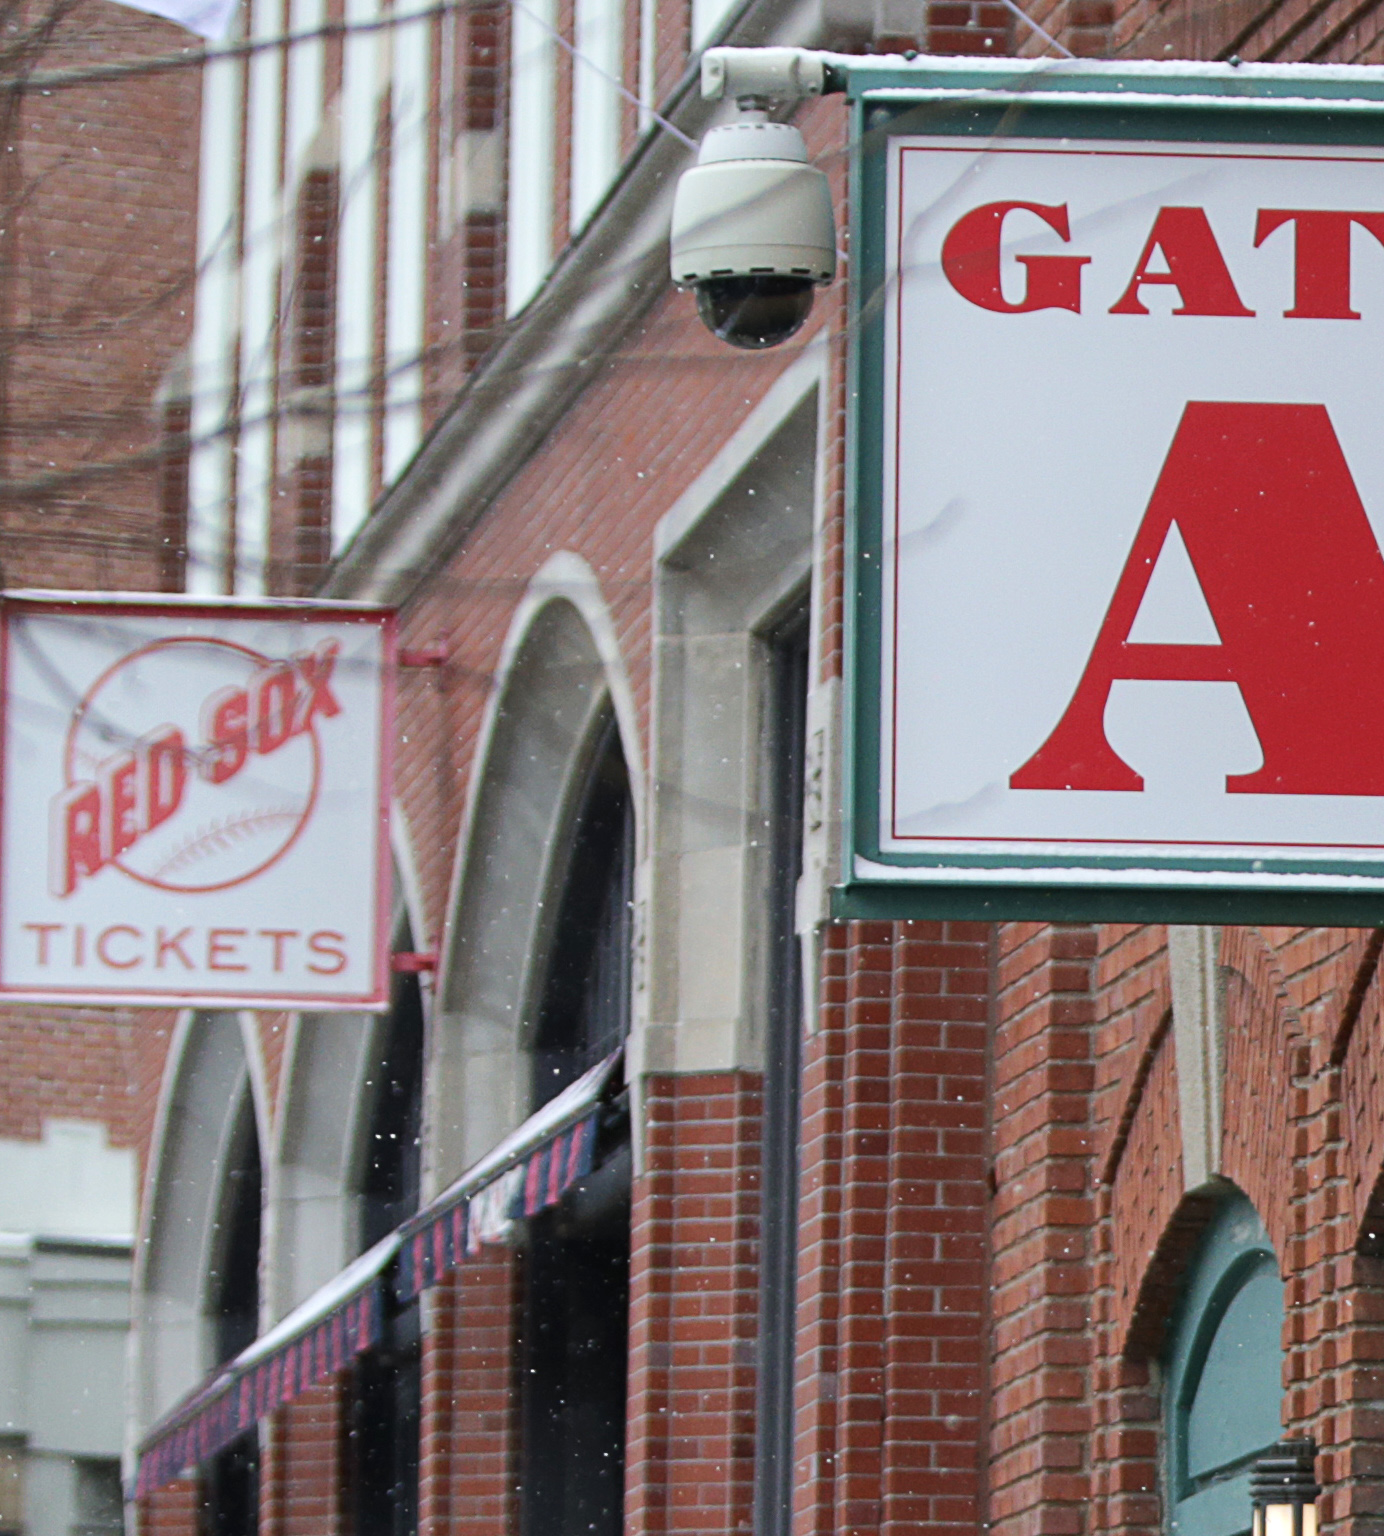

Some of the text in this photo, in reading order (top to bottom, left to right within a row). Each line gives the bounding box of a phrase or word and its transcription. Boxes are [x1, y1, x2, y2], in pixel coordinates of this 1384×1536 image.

[49, 637, 342, 899] RED SOX
[22, 923, 349, 975] TICKETS
